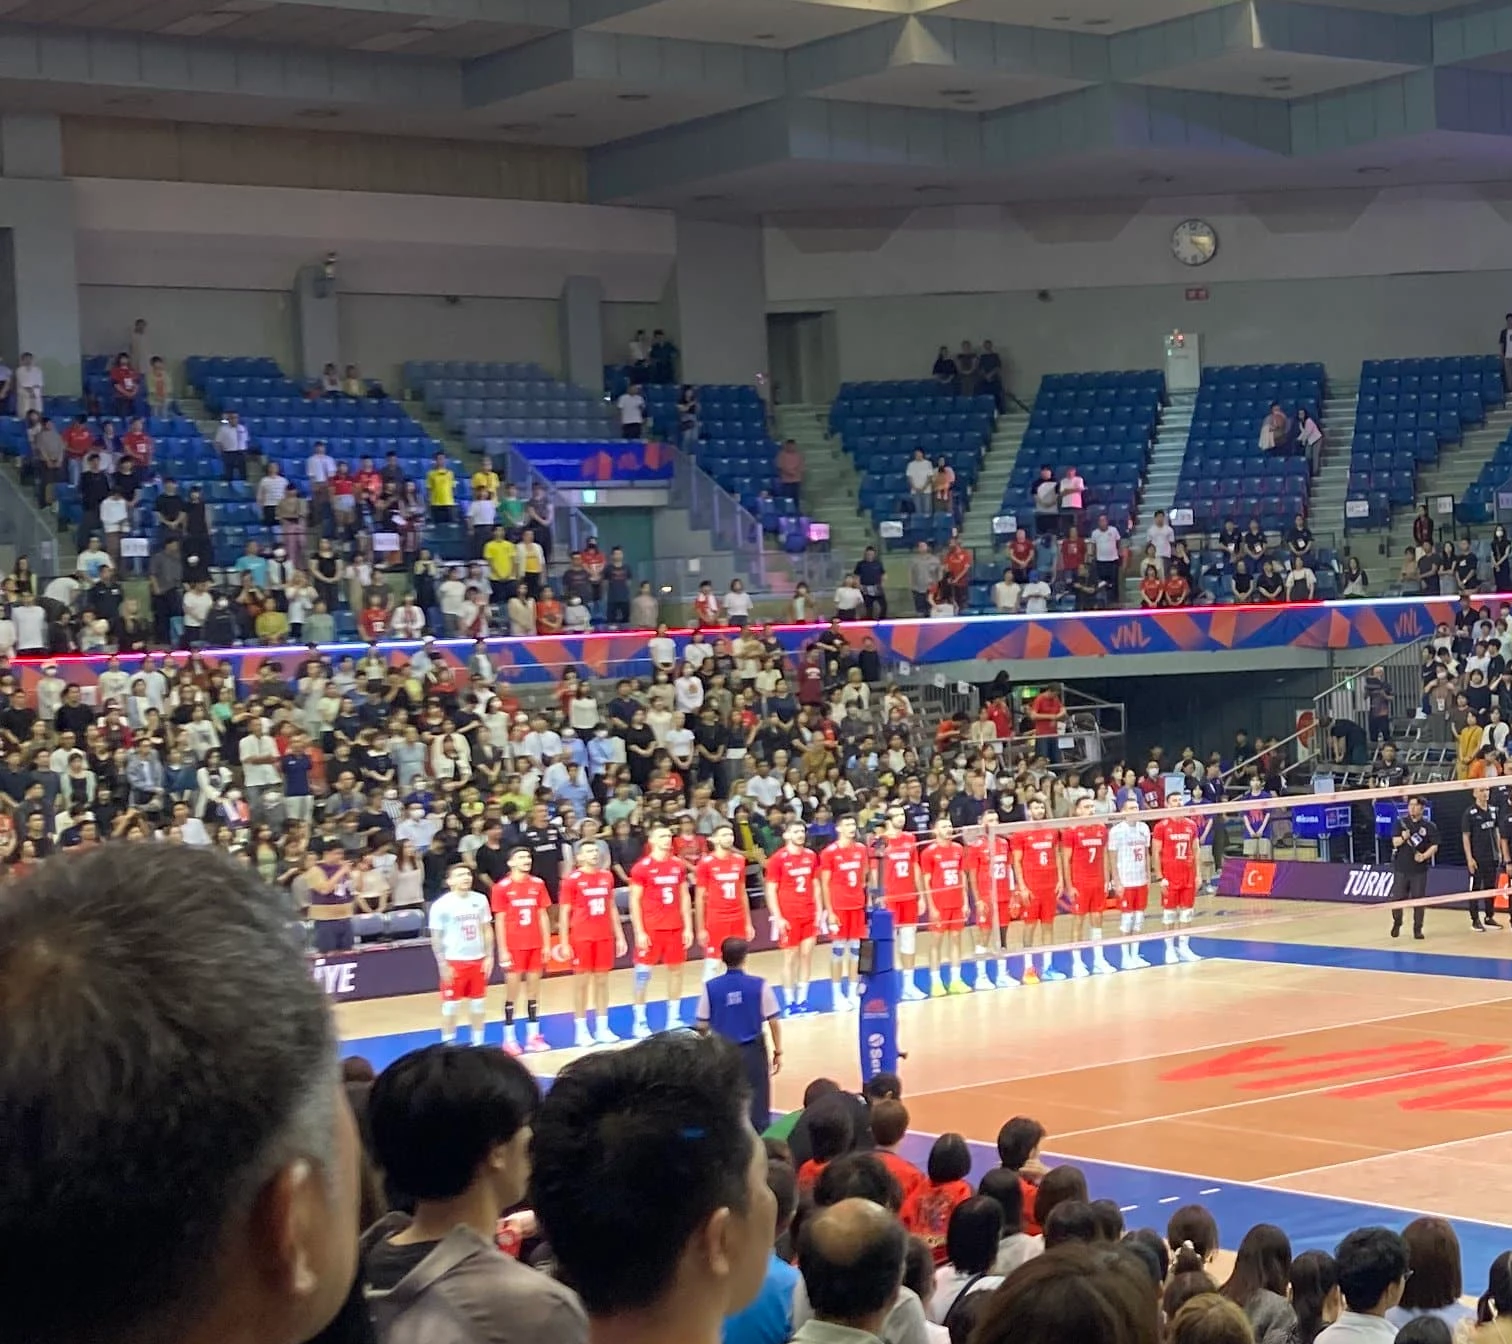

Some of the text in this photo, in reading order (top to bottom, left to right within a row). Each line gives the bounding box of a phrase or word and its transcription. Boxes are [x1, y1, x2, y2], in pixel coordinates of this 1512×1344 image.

[1088, 846, 1097, 863] 7
[795, 876, 806, 893] 2
[518, 909, 532, 926] 3
